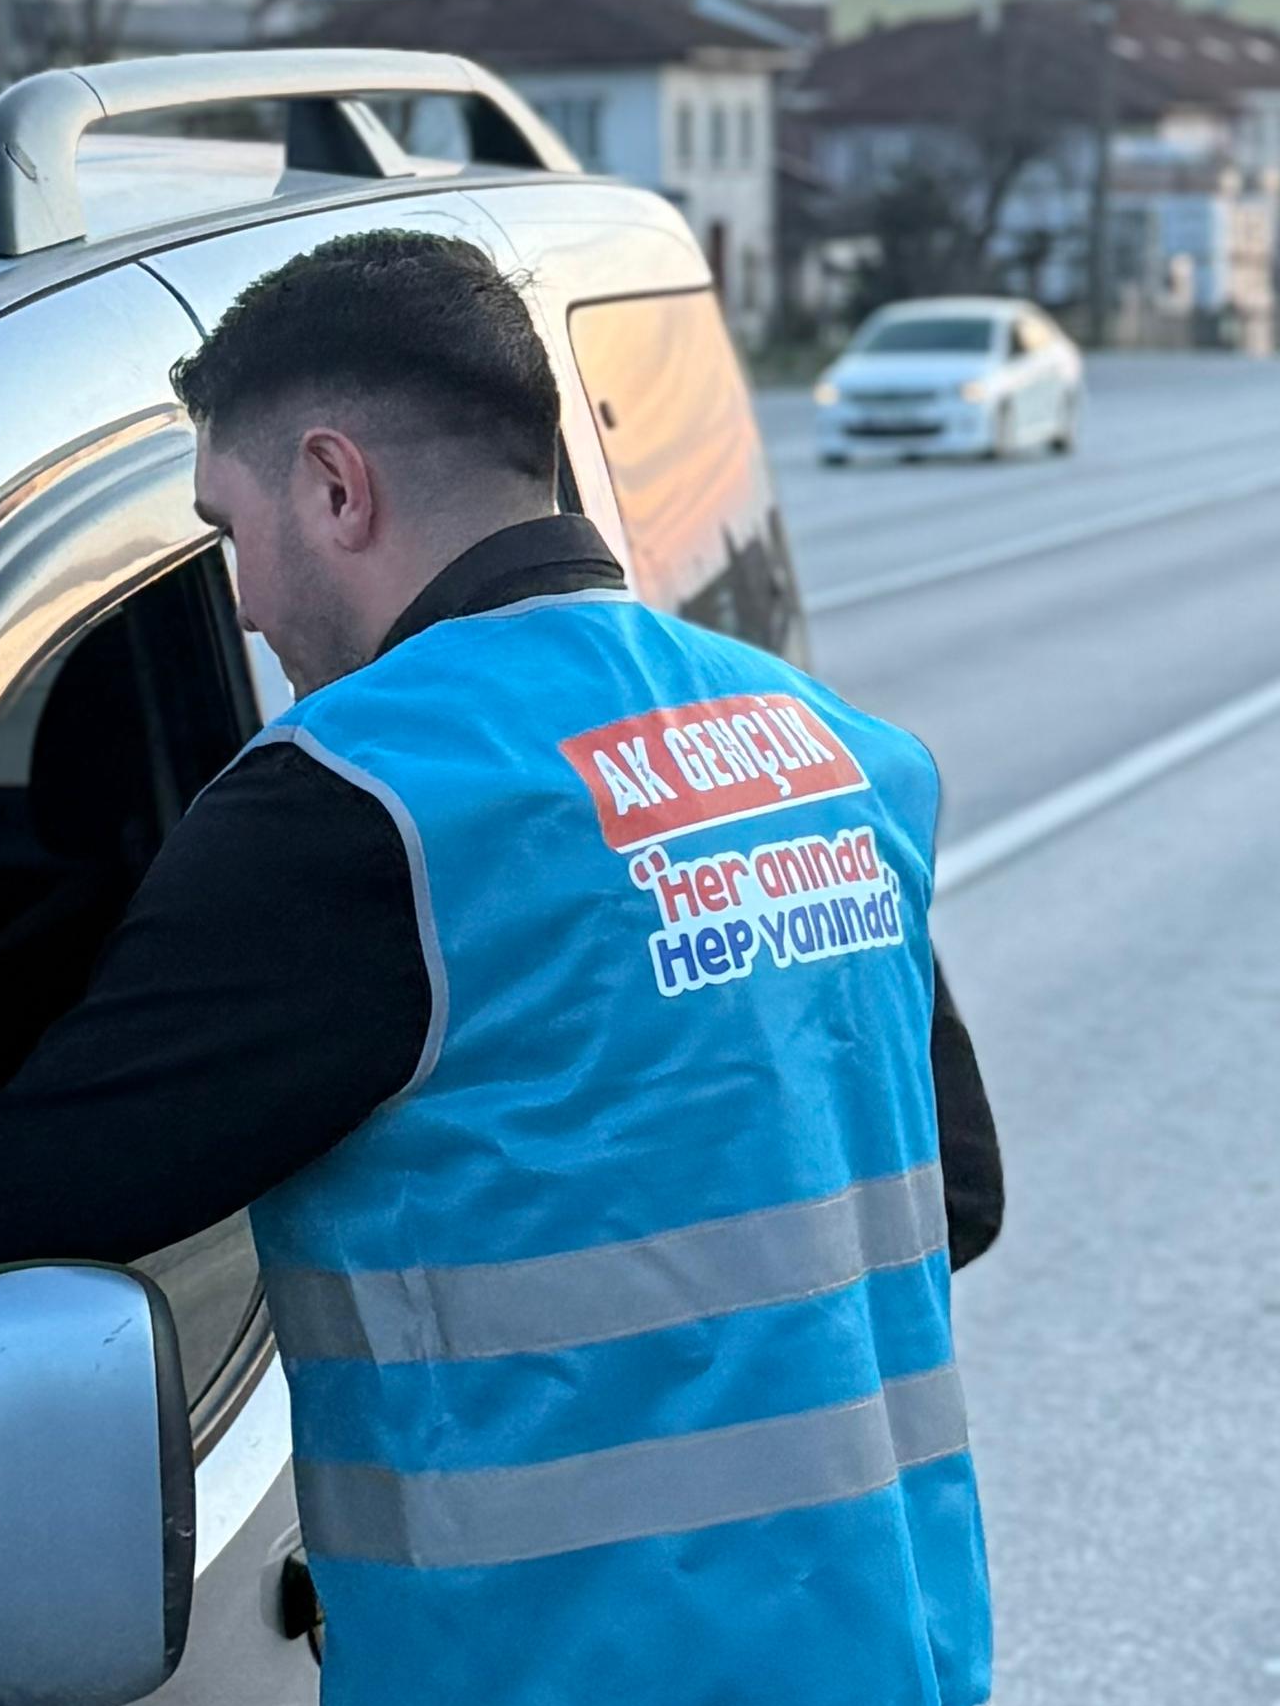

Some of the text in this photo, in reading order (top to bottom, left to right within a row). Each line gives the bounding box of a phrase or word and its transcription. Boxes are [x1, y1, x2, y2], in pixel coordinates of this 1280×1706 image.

[592, 696, 837, 816] AK GENÇLİK
[756, 833, 879, 898] anında
[656, 918, 754, 988] Hep
